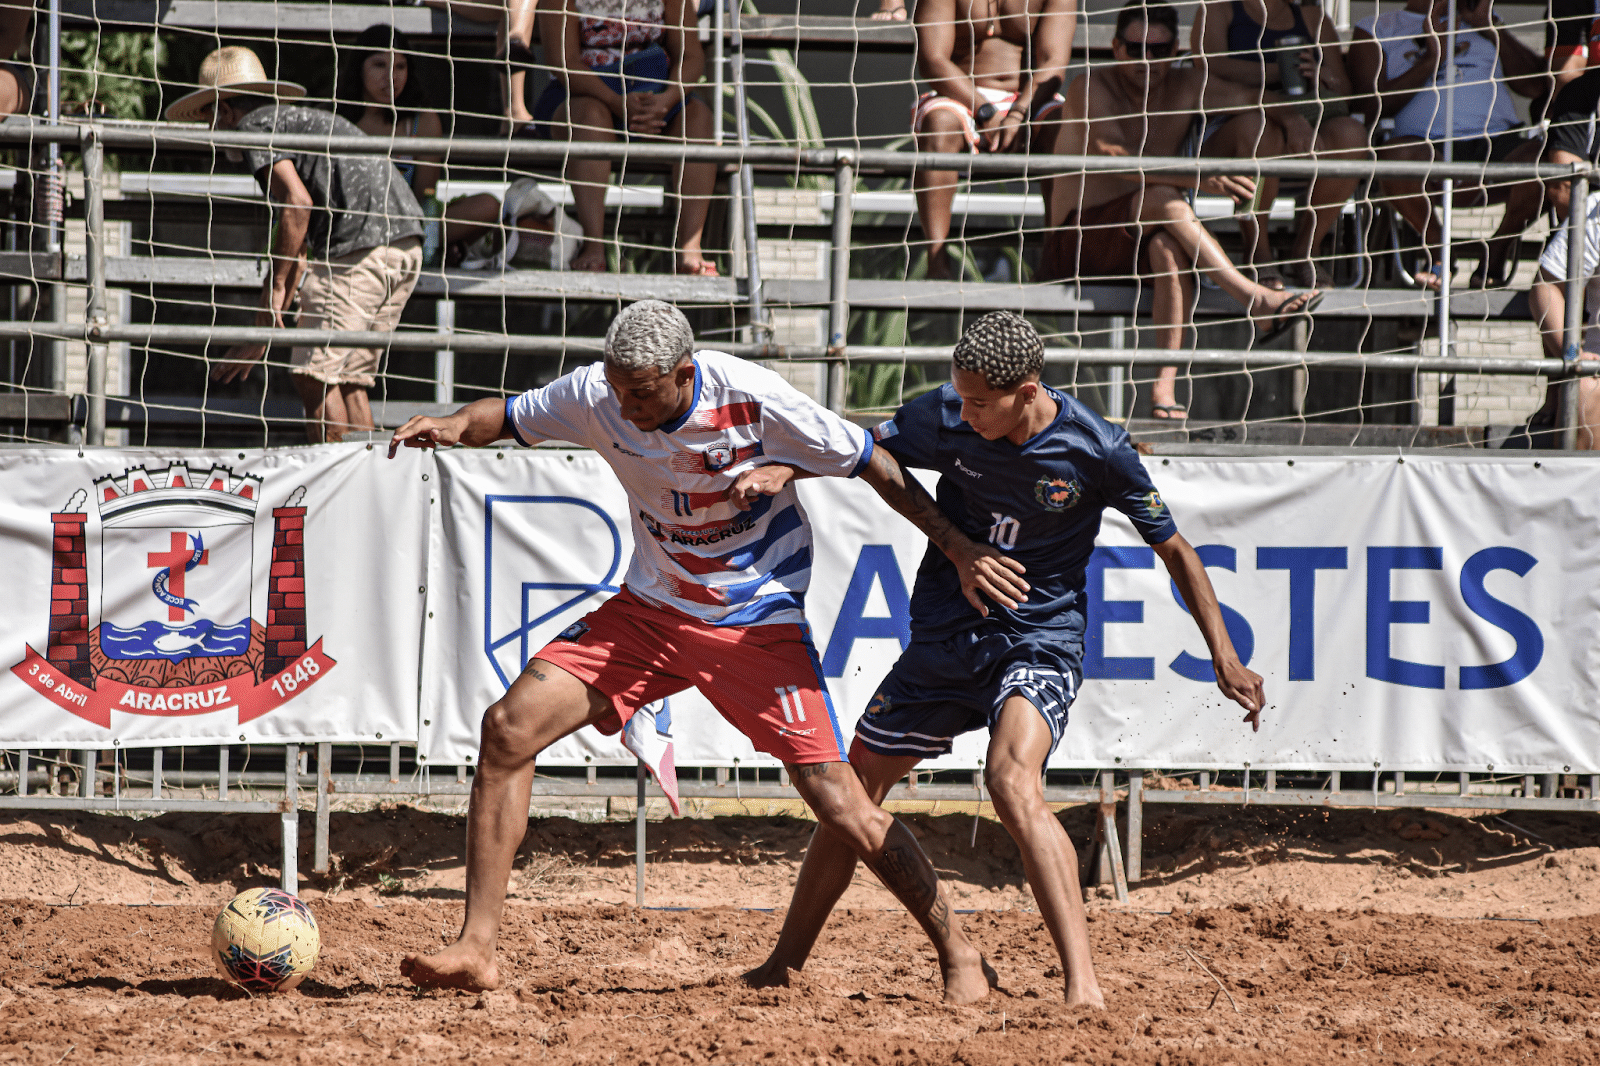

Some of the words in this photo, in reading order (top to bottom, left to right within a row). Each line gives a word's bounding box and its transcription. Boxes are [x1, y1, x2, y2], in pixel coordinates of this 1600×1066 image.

[670, 489, 693, 517] 11
[671, 515, 756, 546] ARACRUZ
[988, 512, 1020, 550] 10
[164, 594, 185, 606] ECCE
[192, 549, 203, 562] DEI
[28, 663, 40, 676] 3
[38, 673, 55, 688] de
[54, 683, 88, 707] Abril
[271, 656, 320, 698] 1848
[119, 685, 231, 711] ARACRUZ
[774, 685, 807, 723] 11
